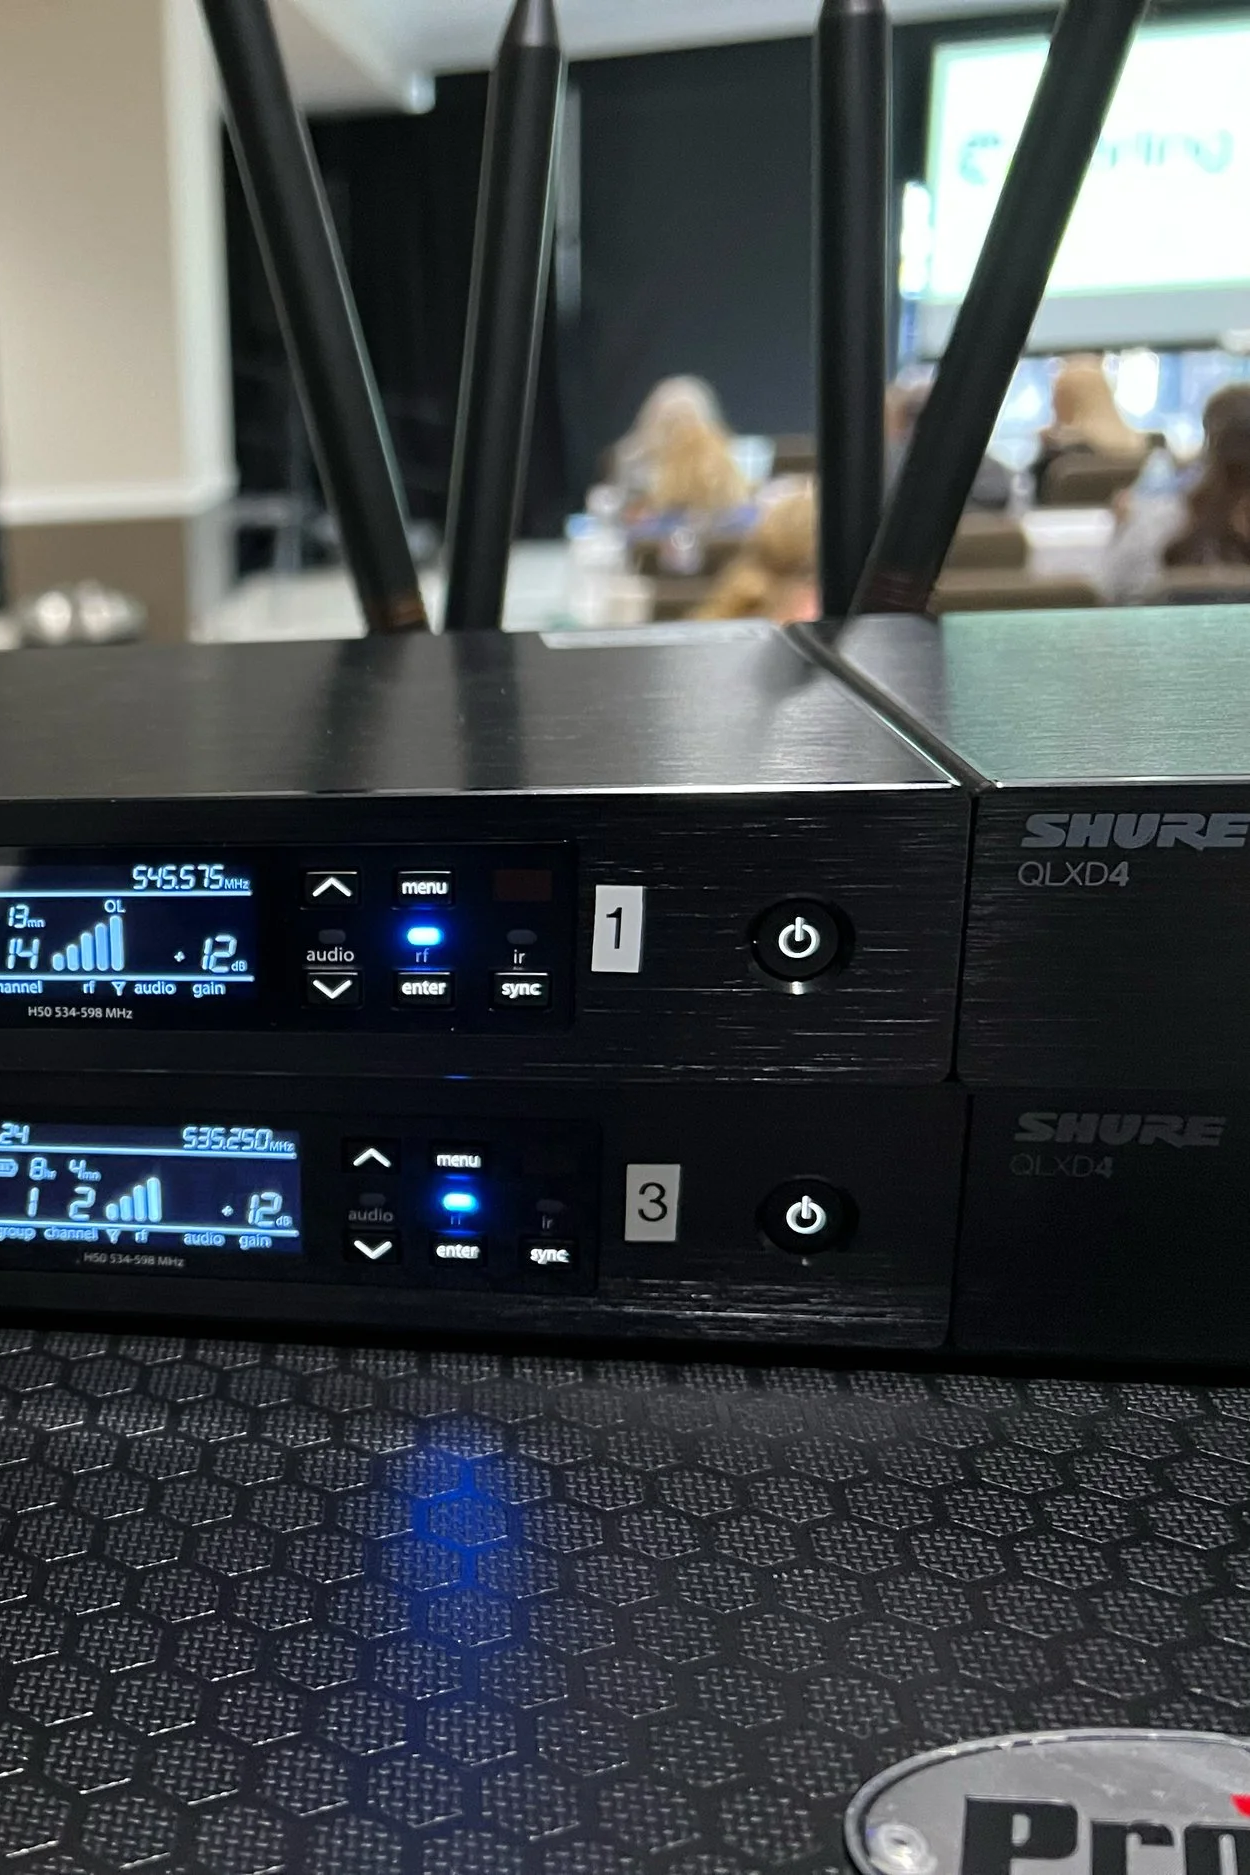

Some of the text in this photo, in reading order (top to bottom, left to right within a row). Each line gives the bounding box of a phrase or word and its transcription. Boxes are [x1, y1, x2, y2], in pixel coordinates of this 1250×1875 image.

[1020, 813, 1250, 851] SHURE
[1017, 861, 1130, 887] QLXD4
[401, 880, 449, 896] menu
[104, 900, 127, 914] OL
[605, 906, 624, 950] 1
[7, 938, 41, 971] 14
[306, 947, 355, 963] audio
[415, 949, 430, 963] rf
[513, 949, 526, 965] ir
[82, 981, 96, 994] rf
[134, 980, 226, 998] audio gain
[401, 981, 447, 996] enter
[501, 982, 543, 998] sync
[28, 1006, 134, 1020] H50 534-598 MHz
[1013, 1111, 1227, 1149] SHURE
[436, 1153, 482, 1169] menu
[1009, 1152, 1114, 1179] QLXD4
[68, 1186, 96, 1221] 2
[637, 1182, 668, 1222] 3
[348, 1207, 394, 1223] audio
[541, 1214, 553, 1229] ir
[43, 1227, 98, 1241] channel
[134, 1228, 148, 1243] rf
[183, 1231, 272, 1250] audio gain
[436, 1243, 480, 1259] enter
[530, 1246, 570, 1265] sync
[109, 1252, 155, 1266] 534-598
[157, 1255, 185, 1268] MHz
